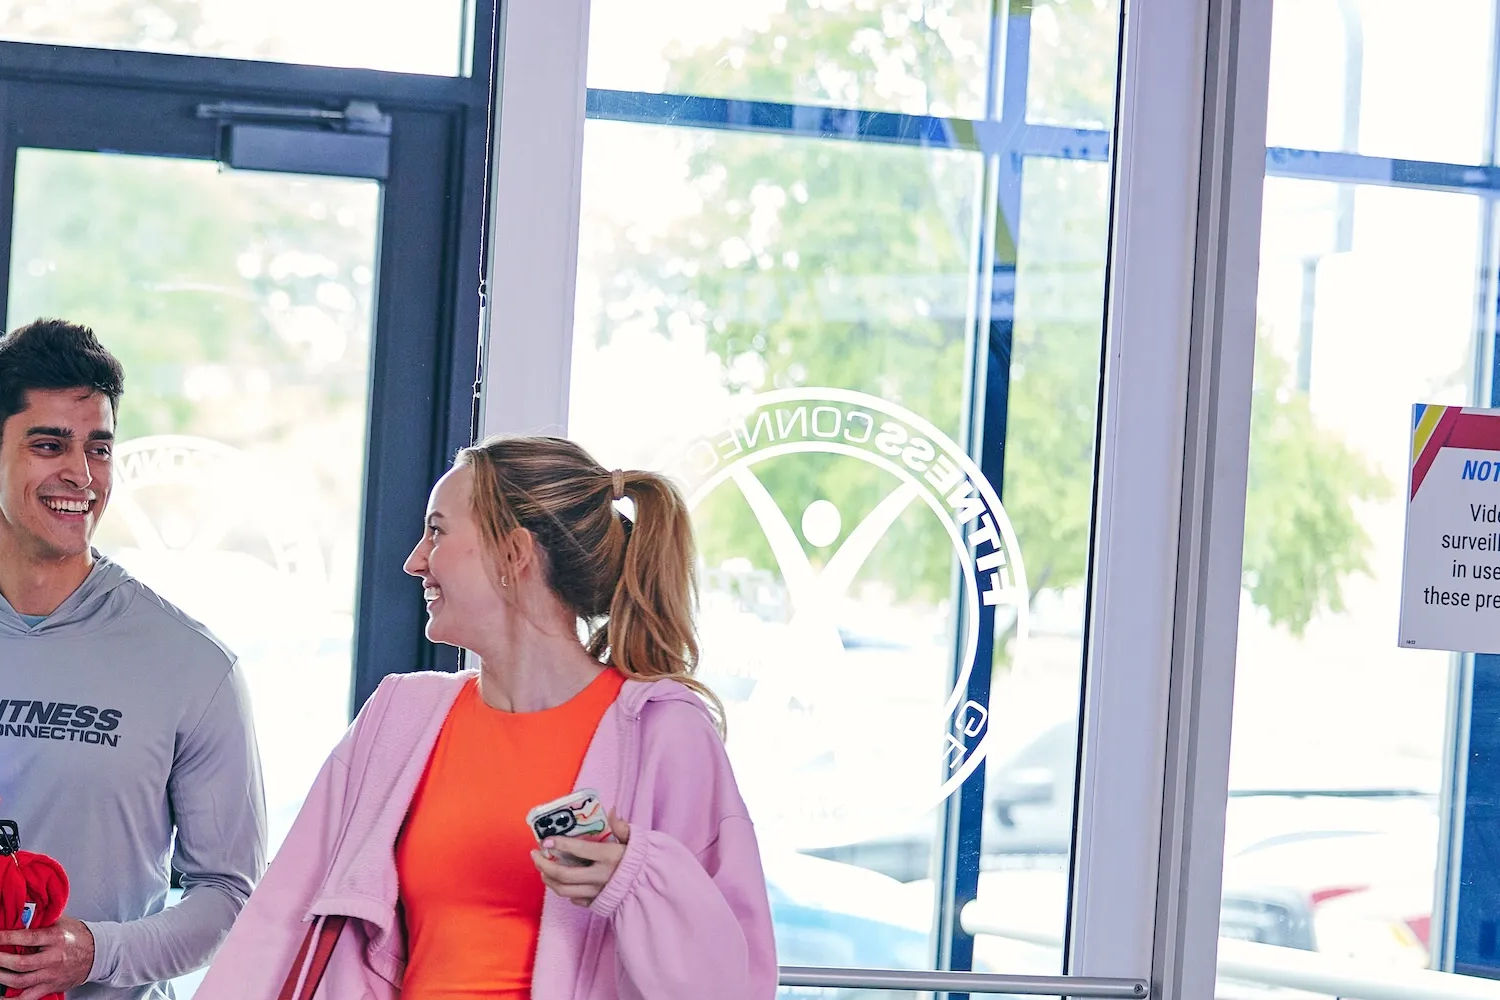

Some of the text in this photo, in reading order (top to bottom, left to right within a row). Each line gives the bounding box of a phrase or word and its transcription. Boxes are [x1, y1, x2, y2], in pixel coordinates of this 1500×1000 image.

[1452, 559, 1500, 580] in use
[1423, 586, 1500, 612] these pre
